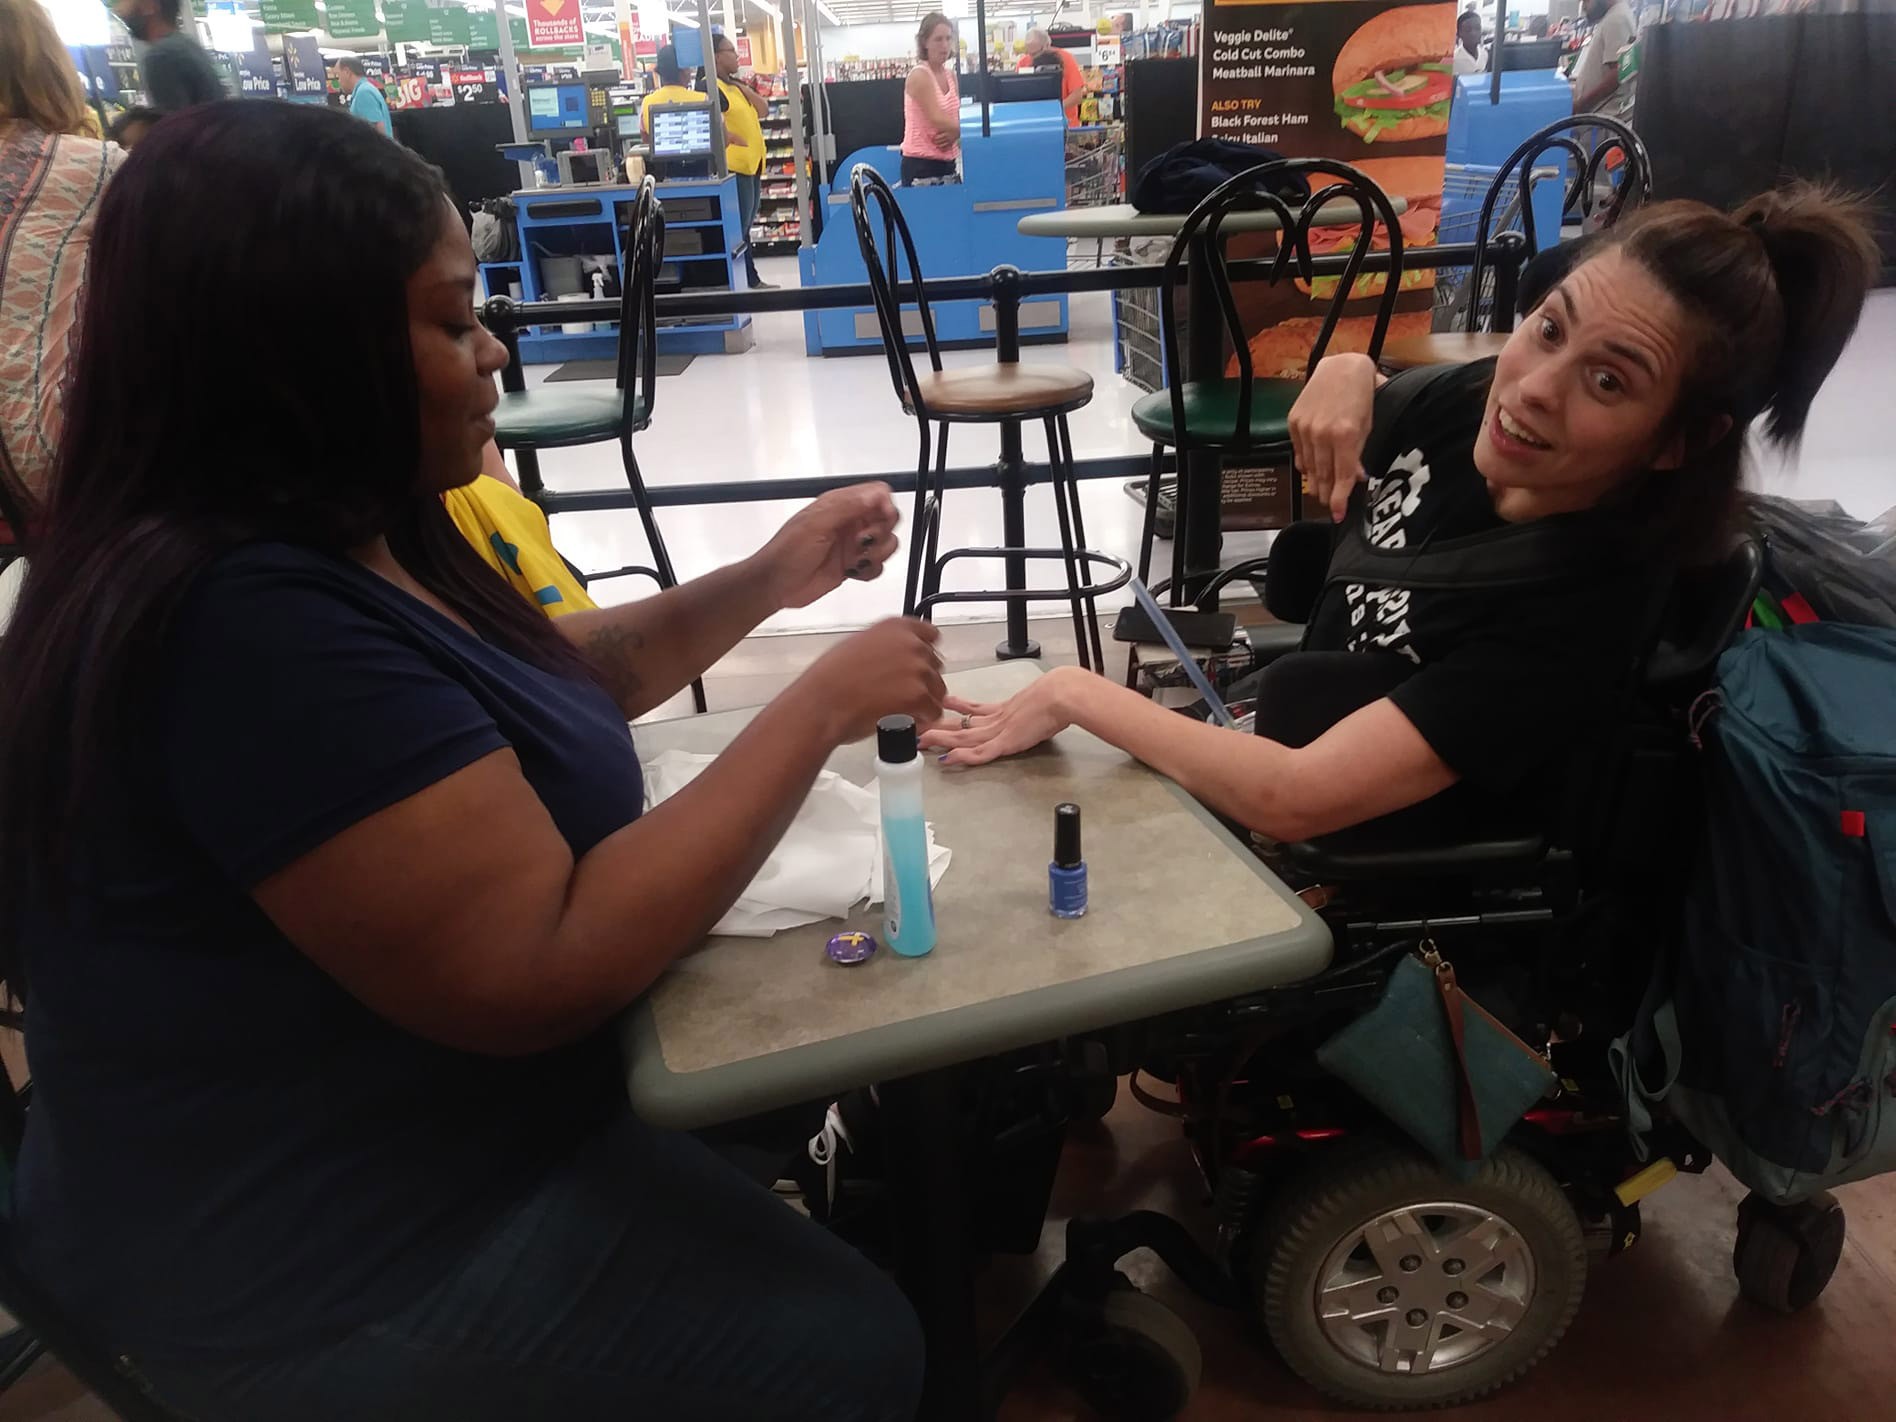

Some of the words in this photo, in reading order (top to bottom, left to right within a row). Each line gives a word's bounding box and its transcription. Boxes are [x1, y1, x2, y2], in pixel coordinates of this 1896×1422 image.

[533, 18, 568, 27] Thousands
[568, 17, 577, 25] of
[534, 25, 579, 35] ROLLBACKS
[1213, 30, 1252, 45] Veggie
[1212, 48, 1240, 61] Cold
[1241, 47, 1262, 60] Cut
[1263, 45, 1306, 60] Combo
[1212, 65, 1262, 79] Meatball
[1263, 64, 1316, 77] Marinara
[252, 76, 270, 91] Price
[295, 78, 307, 92] Low
[307, 77, 321, 91] Price
[1211, 100, 1240, 112] ALSO
[1240, 99, 1262, 110] TRY
[1211, 114, 1242, 128] Black
[1242, 113, 1280, 127] Forest
[1281, 112, 1309, 125] Ham
[1242, 131, 1279, 144] Italian
